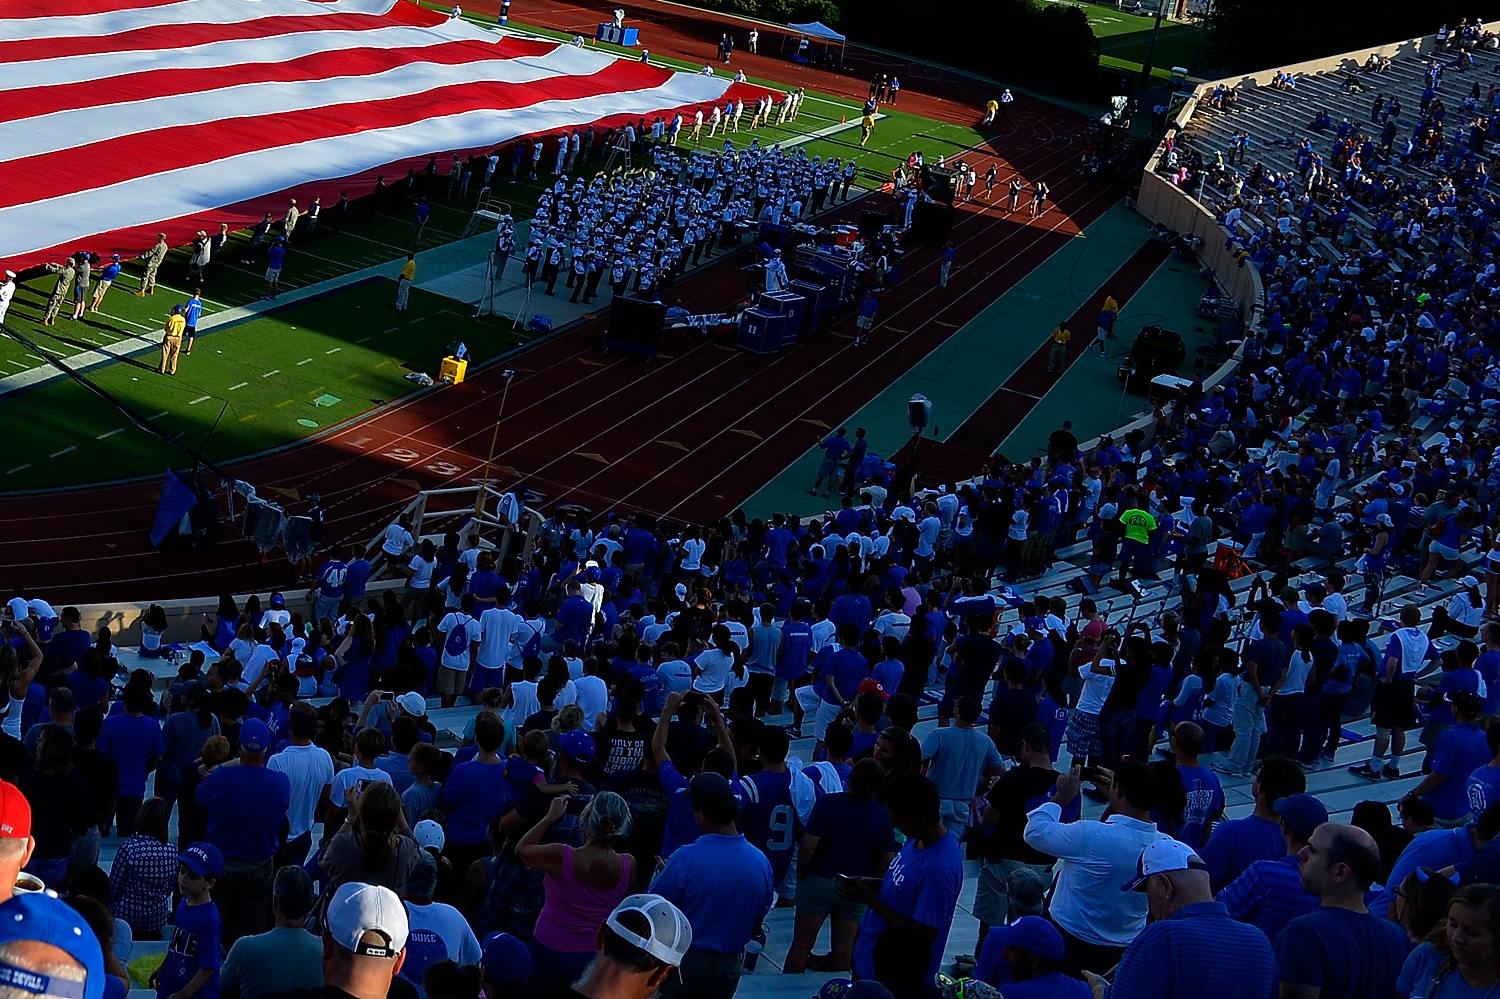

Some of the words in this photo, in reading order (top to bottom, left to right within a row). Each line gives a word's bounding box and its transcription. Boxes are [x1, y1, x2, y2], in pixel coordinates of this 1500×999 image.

[326, 568, 348, 588] 40
[611, 738, 632, 747] ONLY
[610, 746, 624, 756] IN
[767, 804, 793, 851] 9
[187, 846, 208, 862] DUKE
[411, 932, 437, 944] DUKE
